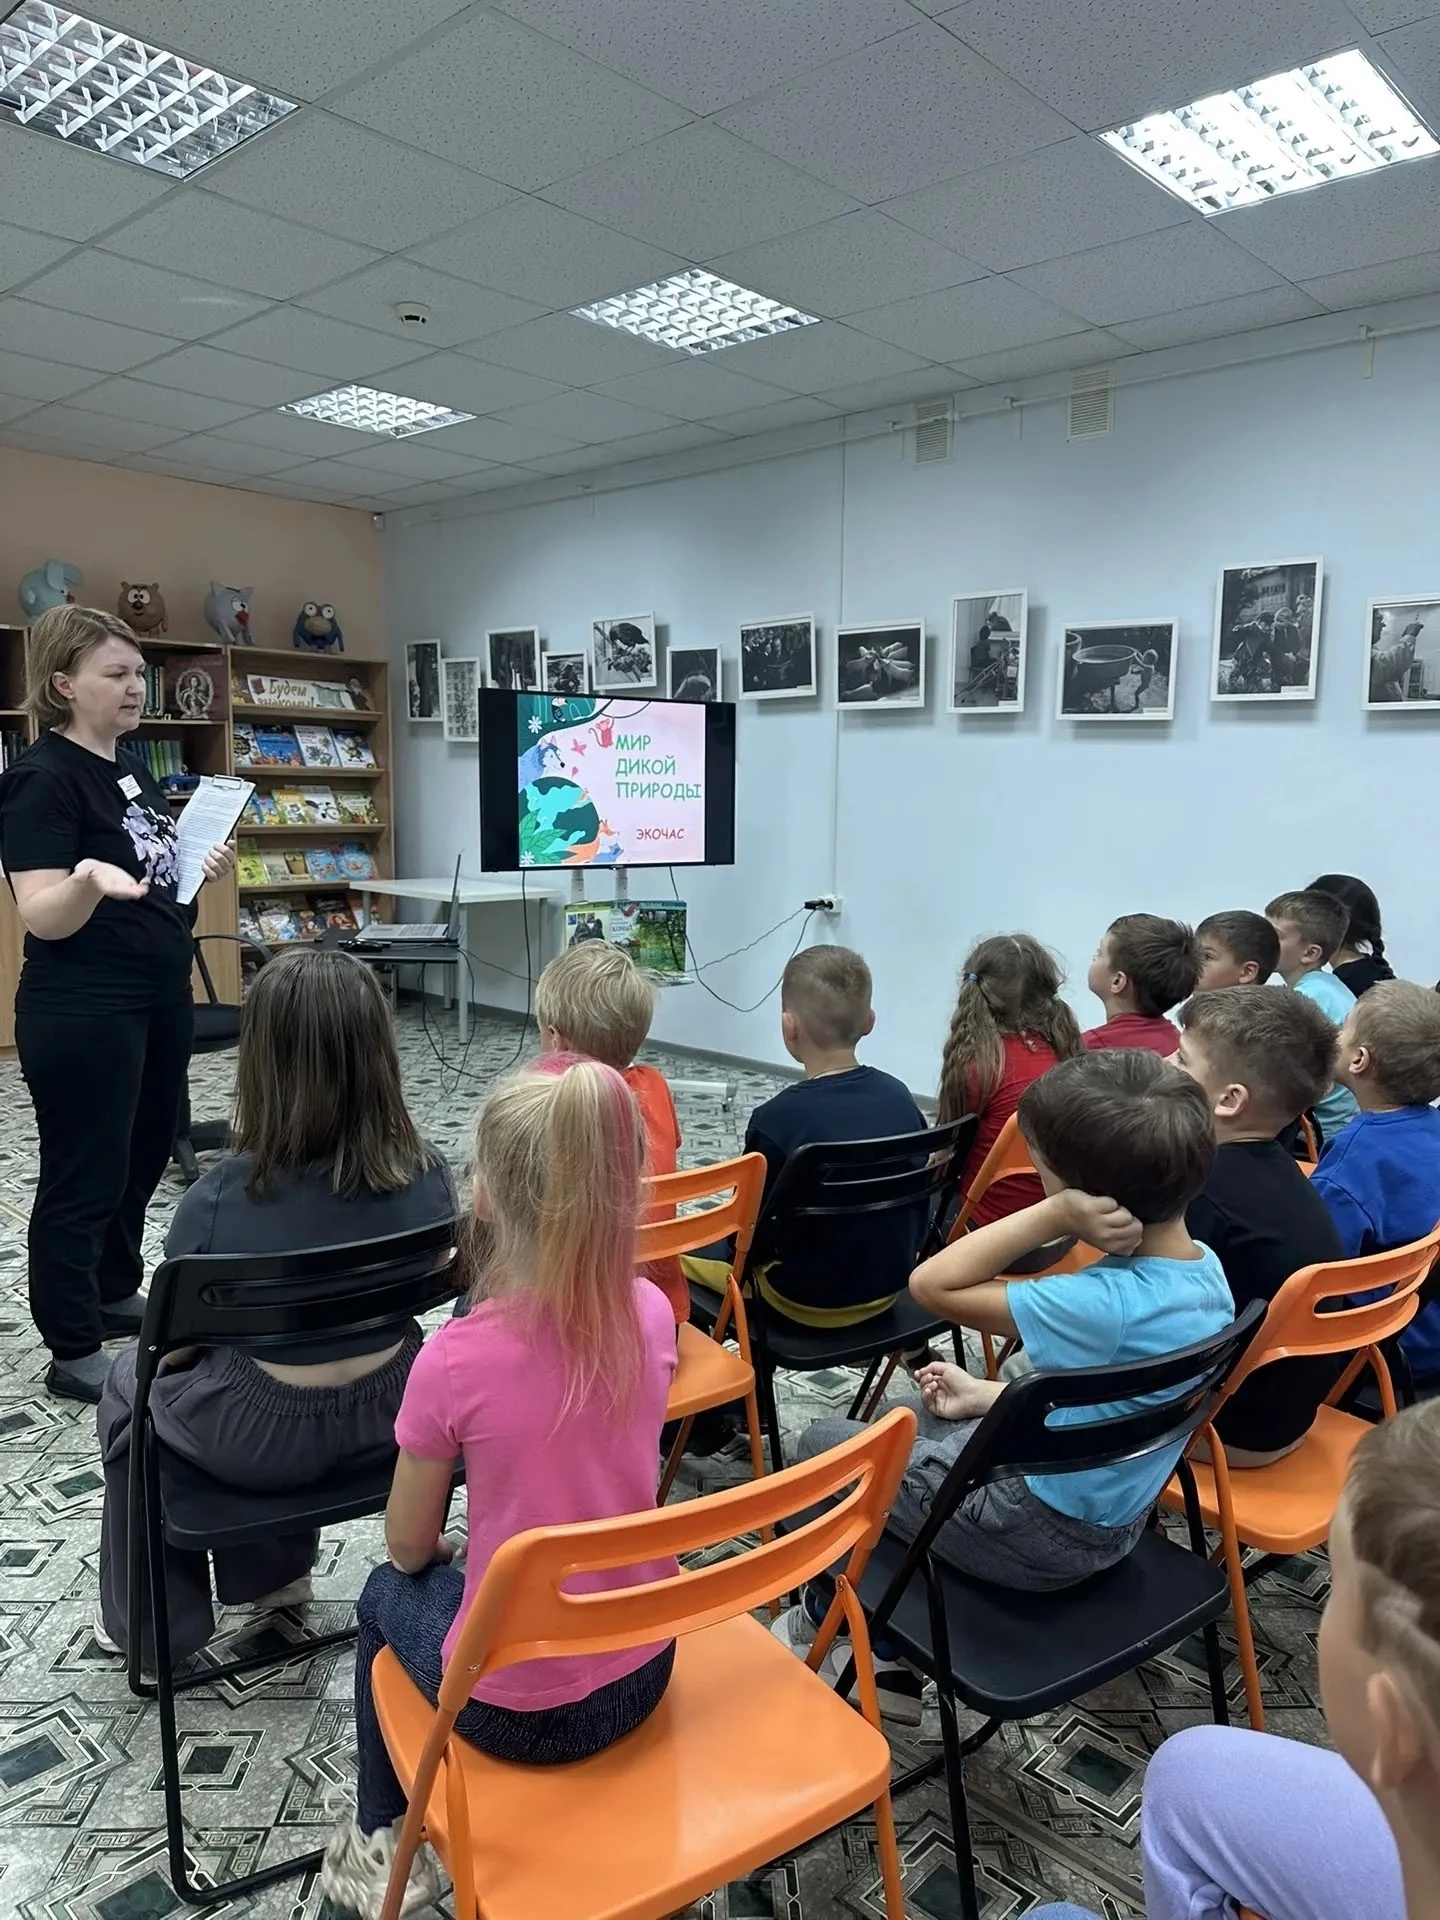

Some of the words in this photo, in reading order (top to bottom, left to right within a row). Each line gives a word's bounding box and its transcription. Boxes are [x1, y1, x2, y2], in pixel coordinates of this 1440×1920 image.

[268, 679, 308, 699] Будем
[615, 734, 652, 751] МИР
[615, 754, 676, 777] ДИКОЙ
[615, 781, 702, 802] ПРИРОДЫ
[636, 828, 685, 840] ЭКОЧАС
